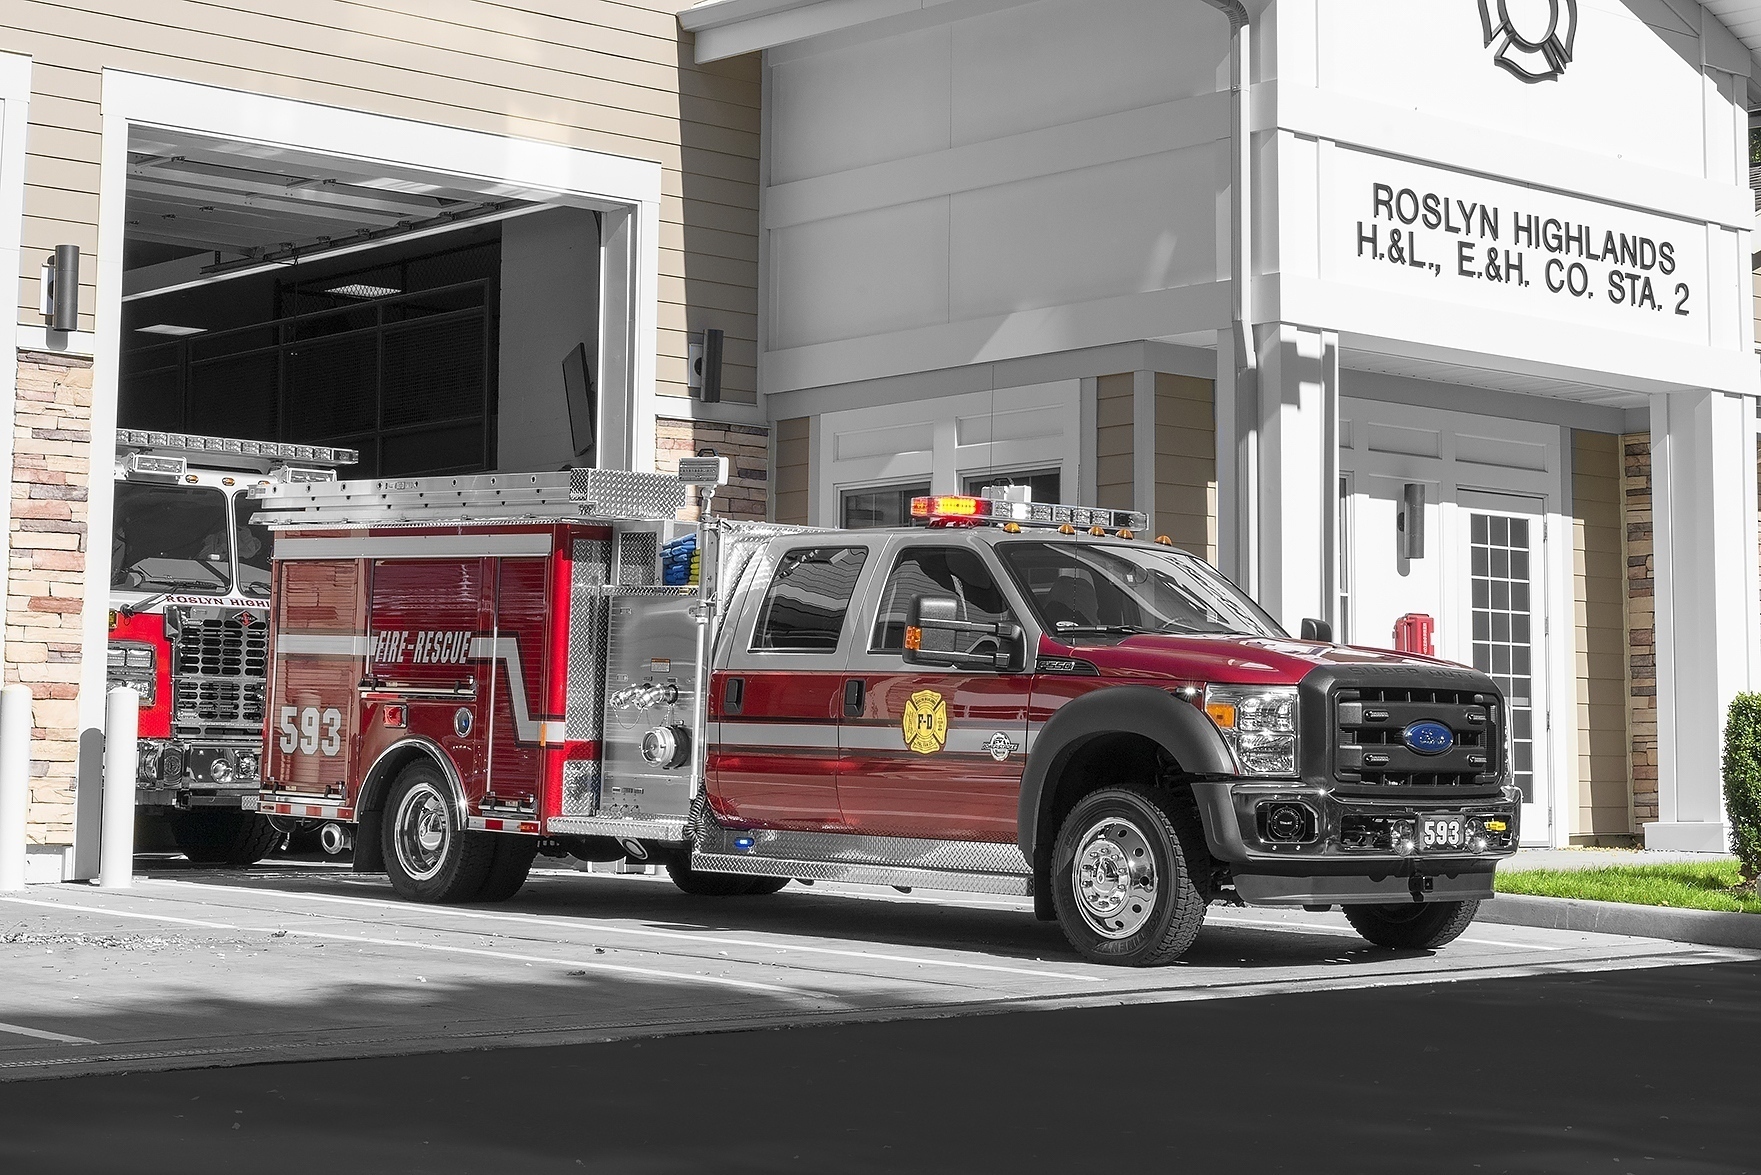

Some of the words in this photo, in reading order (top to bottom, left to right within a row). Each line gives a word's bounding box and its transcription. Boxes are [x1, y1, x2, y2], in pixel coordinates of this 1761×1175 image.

[1372, 182, 1499, 242] ROSLYN
[1513, 211, 1676, 276] HIGHLANDS
[1356, 221, 1442, 277] H.&L.,
[1457, 240, 1531, 288] E.&H.
[1544, 258, 1594, 300] CO.
[1607, 269, 1663, 312] STA.
[1674, 282, 1690, 316] 2
[165, 594, 225, 606] ROSLYN
[375, 630, 472, 664] FIRE-RESCUE
[1348, 666, 1420, 677] SUPER
[1427, 668, 1474, 679] DUTY
[279, 706, 342, 756] 593
[918, 714, 933, 729] F-D
[1424, 820, 1460, 845] 593
